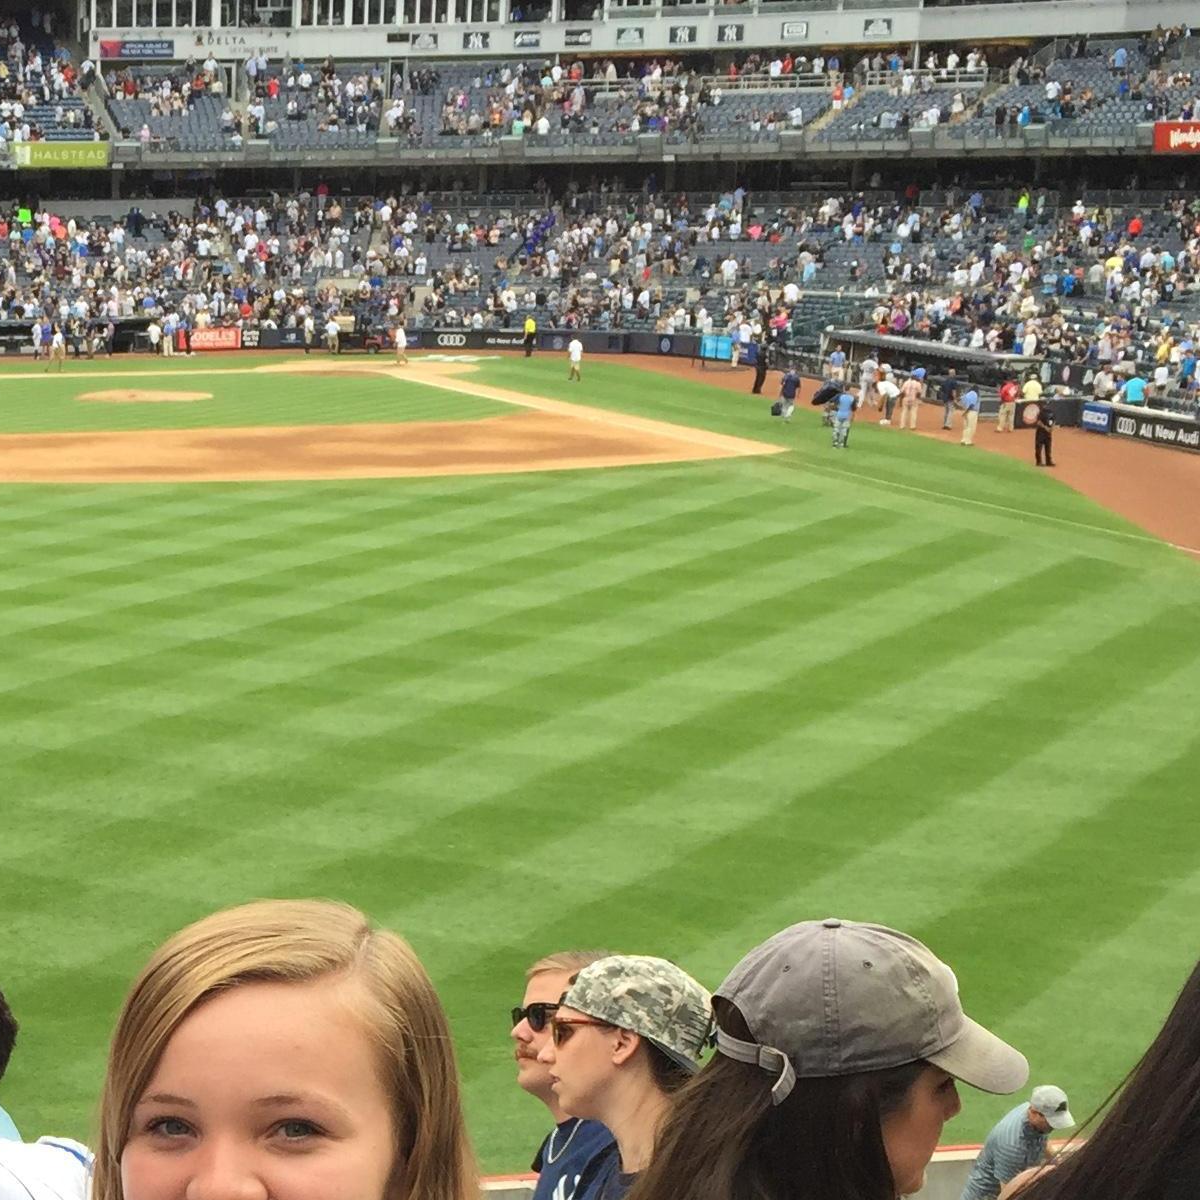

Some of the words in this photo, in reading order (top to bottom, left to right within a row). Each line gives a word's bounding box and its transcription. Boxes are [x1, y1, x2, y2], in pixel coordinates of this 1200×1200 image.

[208, 35, 246, 45] DELTA
[34, 150, 106, 160] HALSTEAD
[1140, 423, 1152, 438] All
[1155, 424, 1177, 439] New
[1177, 429, 1199, 445] Audi
